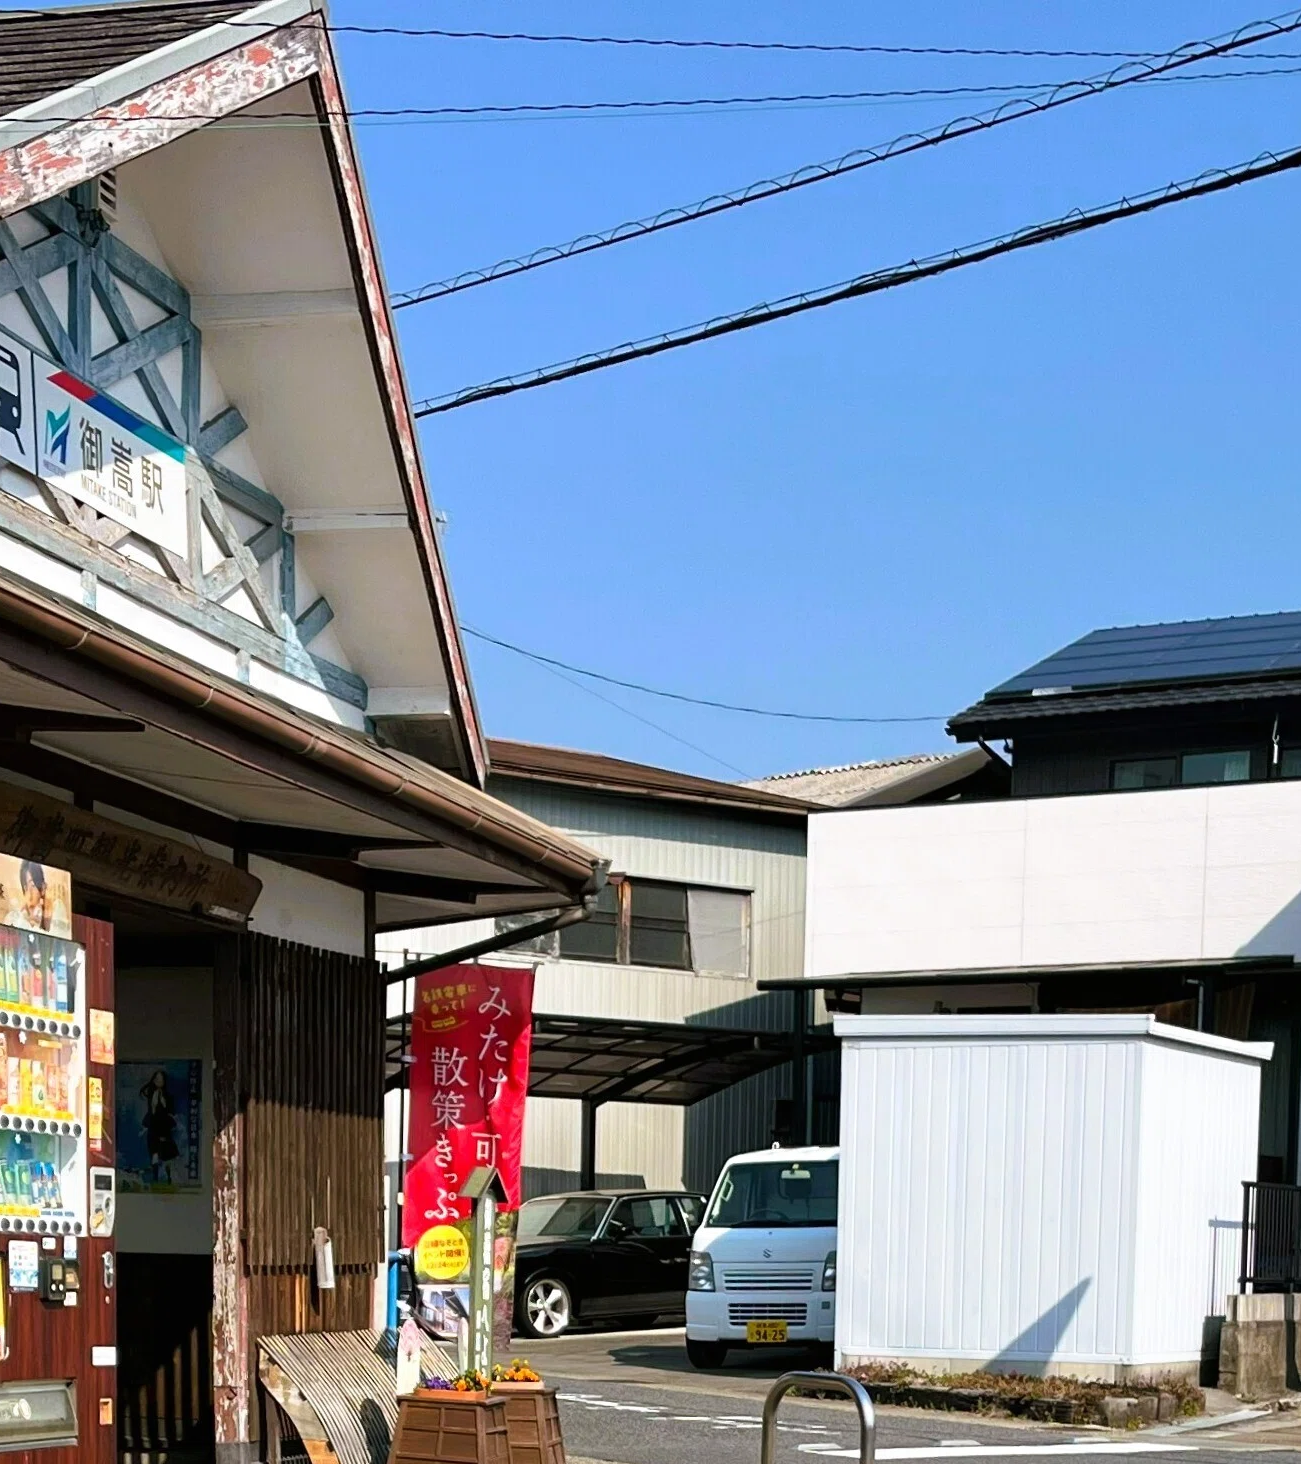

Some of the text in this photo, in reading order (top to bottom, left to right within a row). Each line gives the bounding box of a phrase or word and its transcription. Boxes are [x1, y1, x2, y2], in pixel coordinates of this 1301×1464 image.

[78, 416, 164, 515] 御嵩駅
[80, 473, 136, 519] MITAKE STATION
[424, 1046, 470, 1220] 散策きっぷ
[471, 986, 512, 1169] みたけ・可
